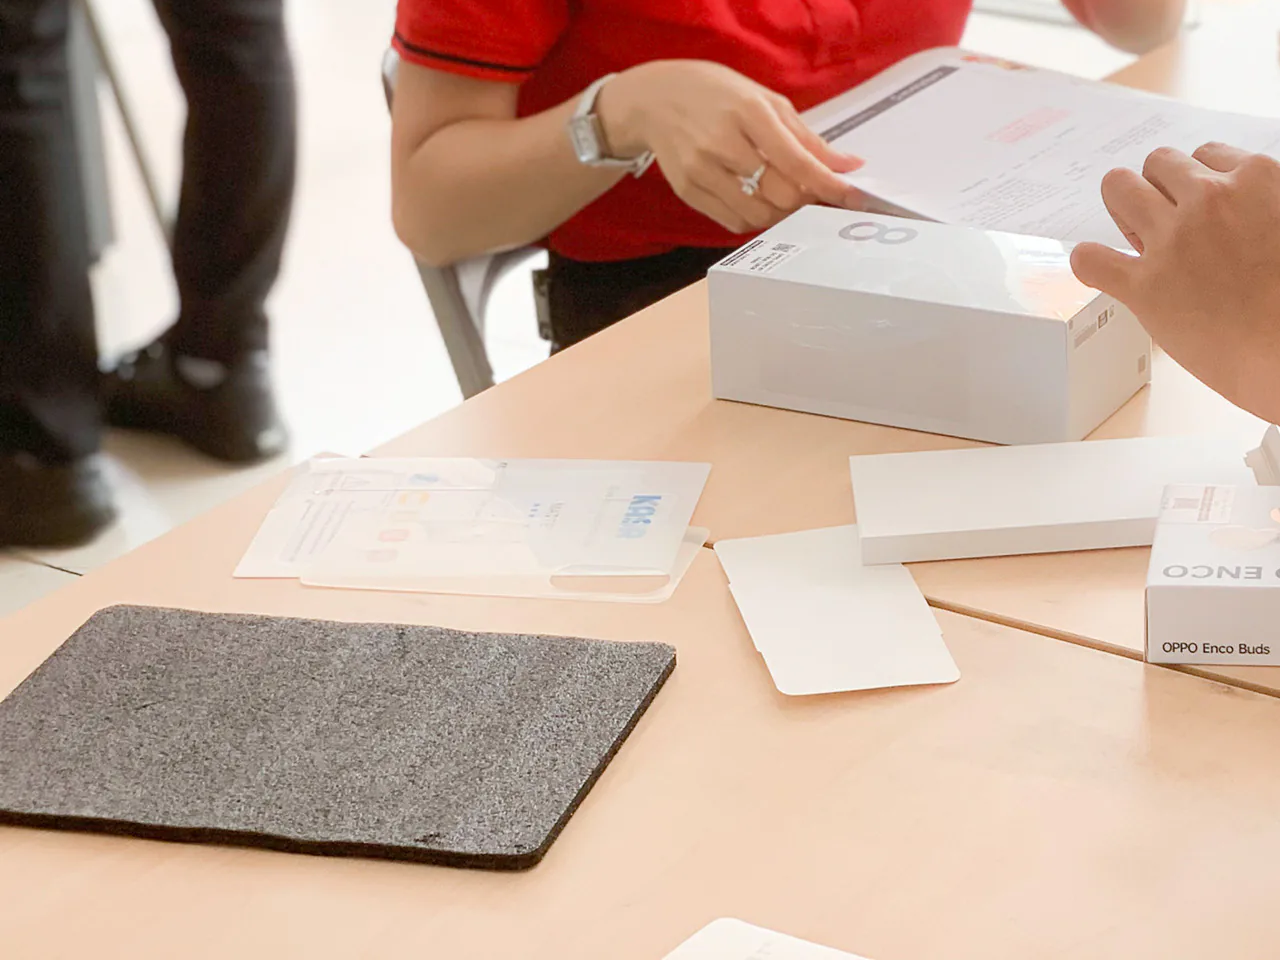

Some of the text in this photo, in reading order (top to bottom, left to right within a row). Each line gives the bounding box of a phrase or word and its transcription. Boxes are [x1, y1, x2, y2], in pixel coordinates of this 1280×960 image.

[1163, 565, 1263, 579] ENCO
[1162, 642, 1270, 654] OPPO Enco Buds
